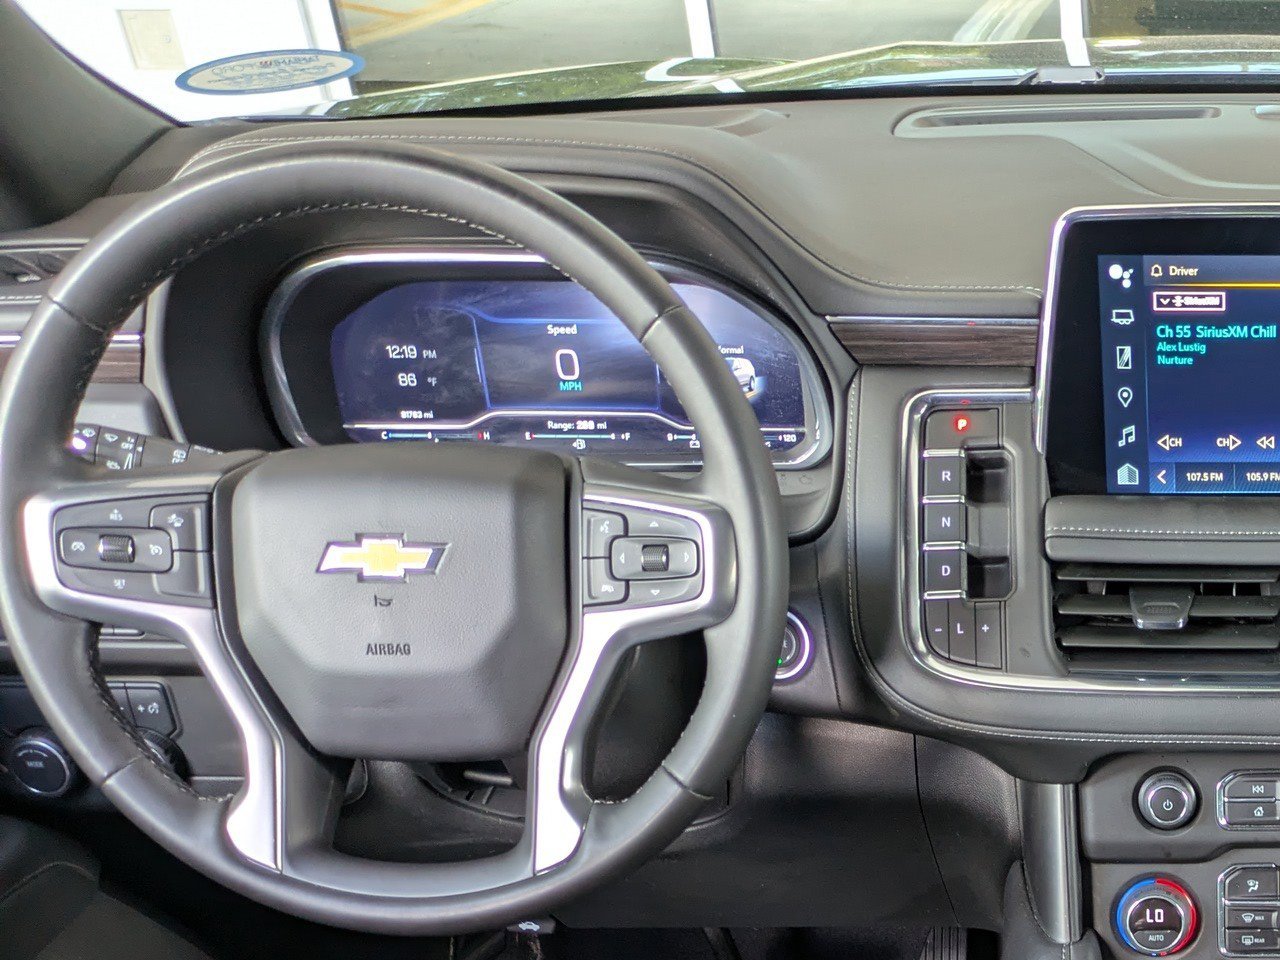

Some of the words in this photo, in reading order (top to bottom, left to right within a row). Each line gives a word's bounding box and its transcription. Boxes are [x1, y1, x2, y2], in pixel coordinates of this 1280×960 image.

[1169, 265, 1198, 276] Driver
[547, 324, 577, 336] Speed
[1156, 325, 1173, 338] Ch
[1176, 325, 1191, 338] 55
[1196, 325, 1248, 338] SiriusXM
[1251, 325, 1277, 338] Chill
[386, 345, 417, 358] 12:19
[423, 350, 437, 359] PM
[1157, 342, 1177, 351] Alex
[1179, 342, 1206, 354] Lustig
[555, 349, 580, 380] 0
[1157, 355, 1194, 365] Nurture
[559, 381, 582, 391] MPH
[547, 420, 575, 431] Range:
[1169, 438, 1182, 447] CH
[1216, 438, 1230, 447] CH
[941, 471, 951, 482] R
[1186, 472, 1209, 482] 107.5
[1210, 472, 1223, 481] FM
[1246, 472, 1269, 482] 105.9
[941, 517, 951, 528] N
[941, 566, 951, 577] D
[957, 623, 964, 634] L
[366, 643, 411, 656] AIRBAG
[1146, 908, 1164, 923] LO
[1148, 934, 1164, 942] AUTO
